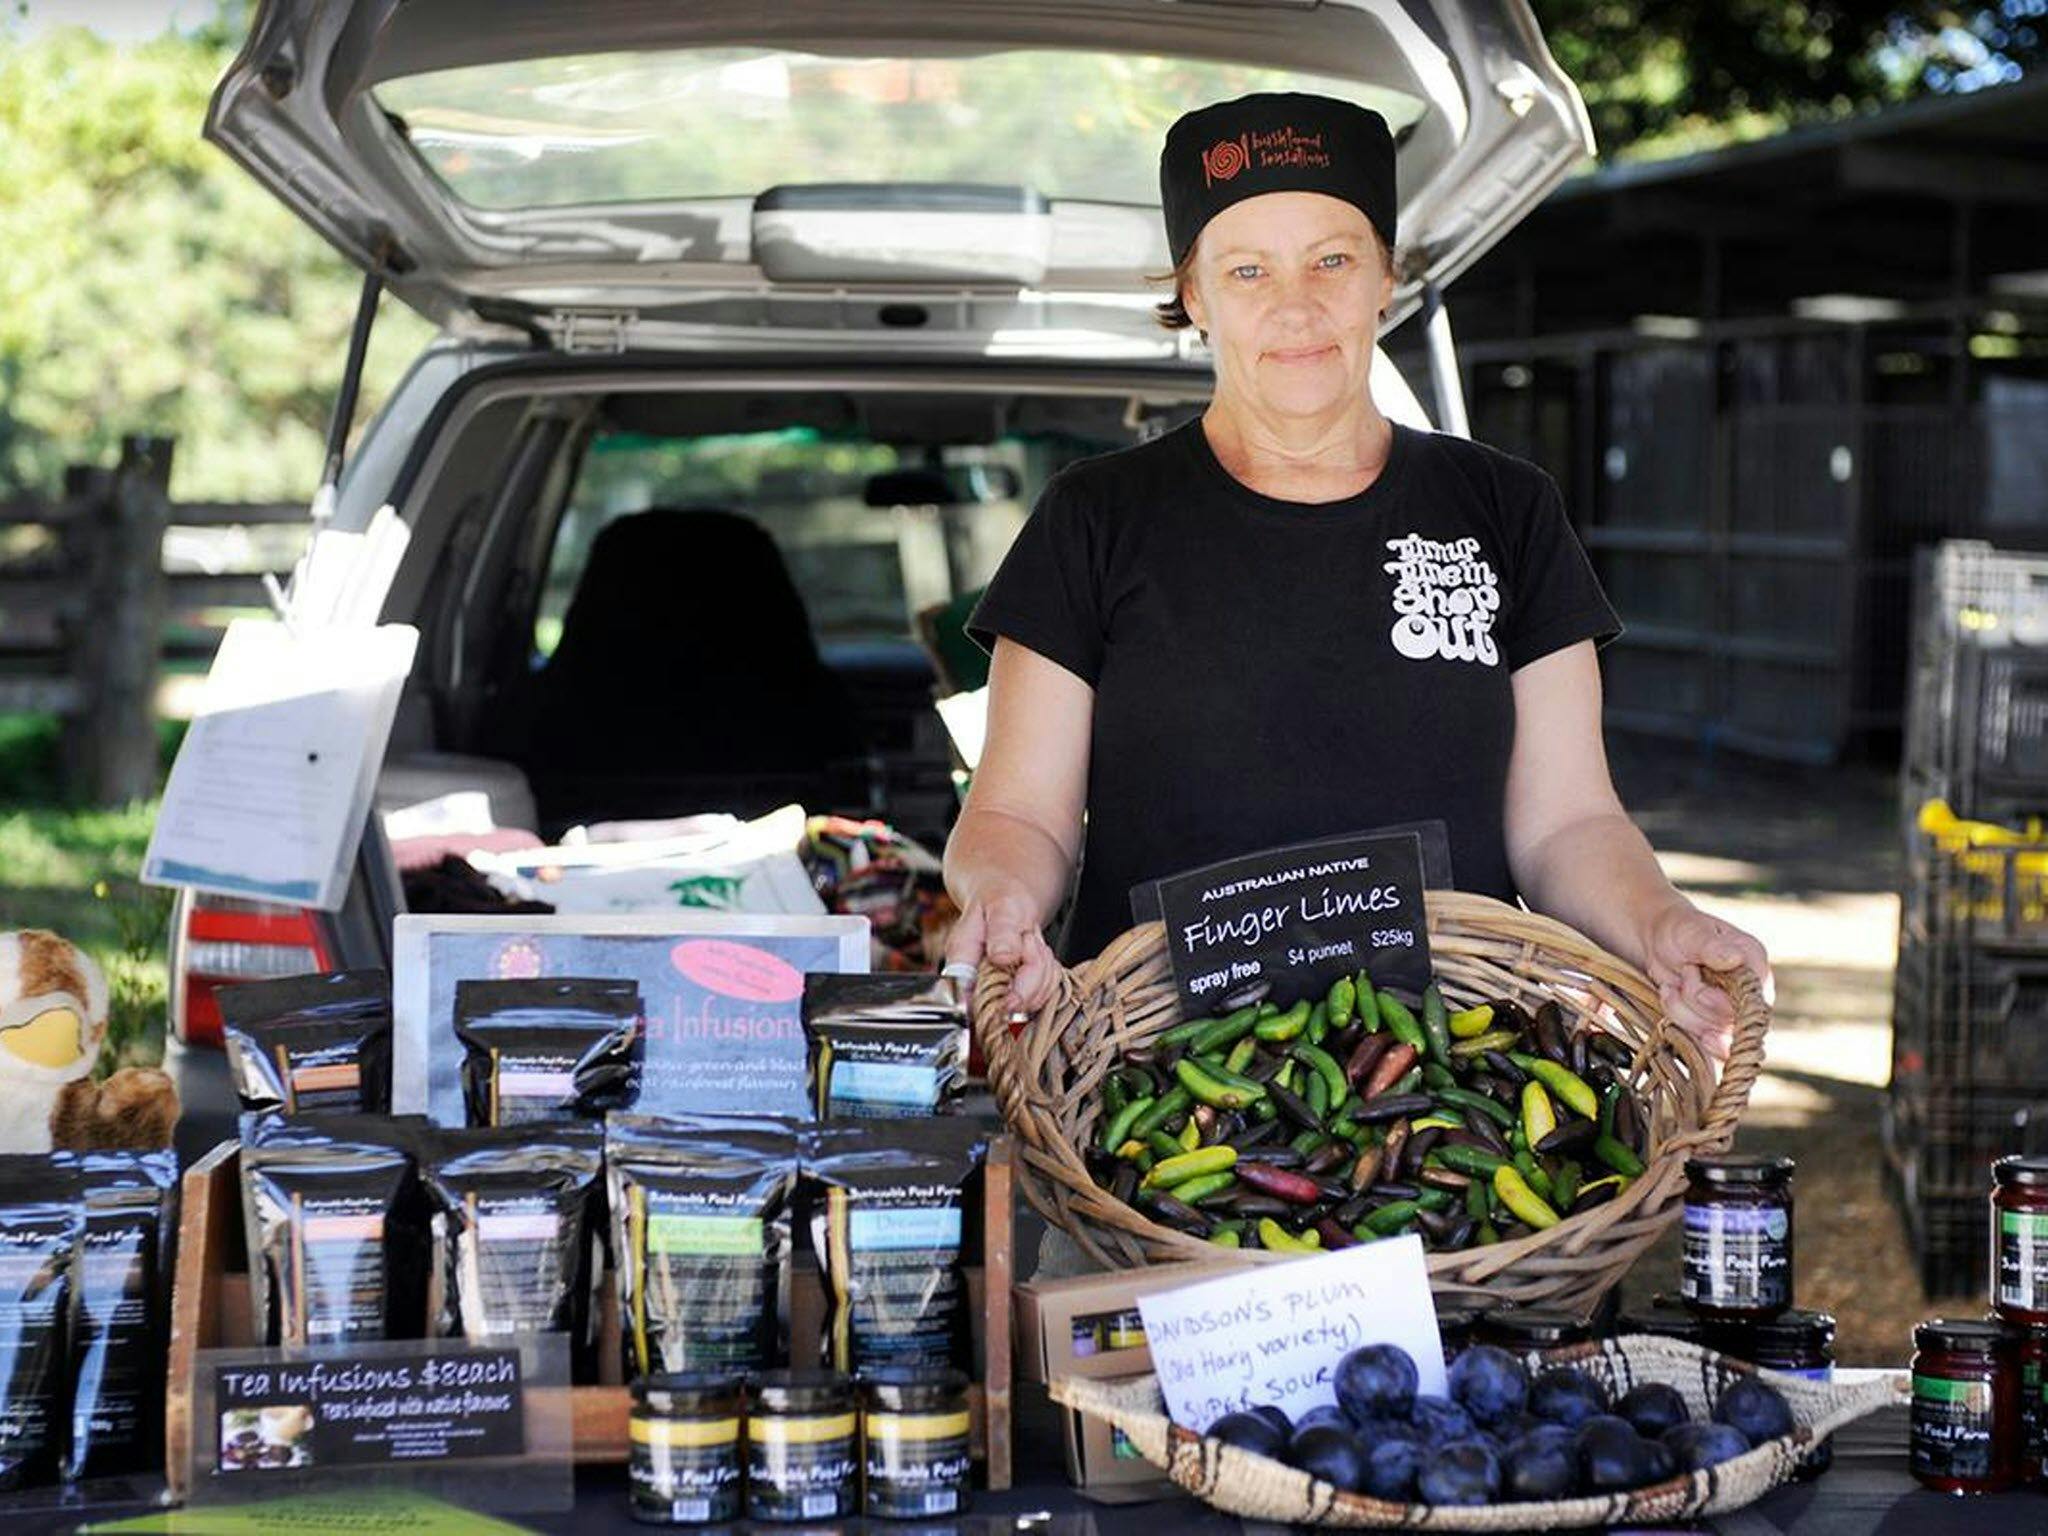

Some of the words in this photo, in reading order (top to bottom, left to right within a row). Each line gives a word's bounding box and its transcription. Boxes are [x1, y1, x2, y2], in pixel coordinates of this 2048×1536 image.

[1391, 613, 1499, 666] Out
[1201, 868, 1305, 902] AUSTRALIAN
[1308, 857, 1370, 878] NATIVE
[1184, 904, 1290, 953] Finger
[1301, 886, 1401, 922] Limes
[1308, 940, 1354, 965] punnet
[1189, 969, 1229, 996] spray
[1231, 960, 1262, 980] free
[1283, 1282, 1365, 1321] PLUM
[222, 1372, 271, 1397] Tea
[279, 1362, 412, 1400] Infusions
[1265, 1366, 1335, 1401] SOUR
